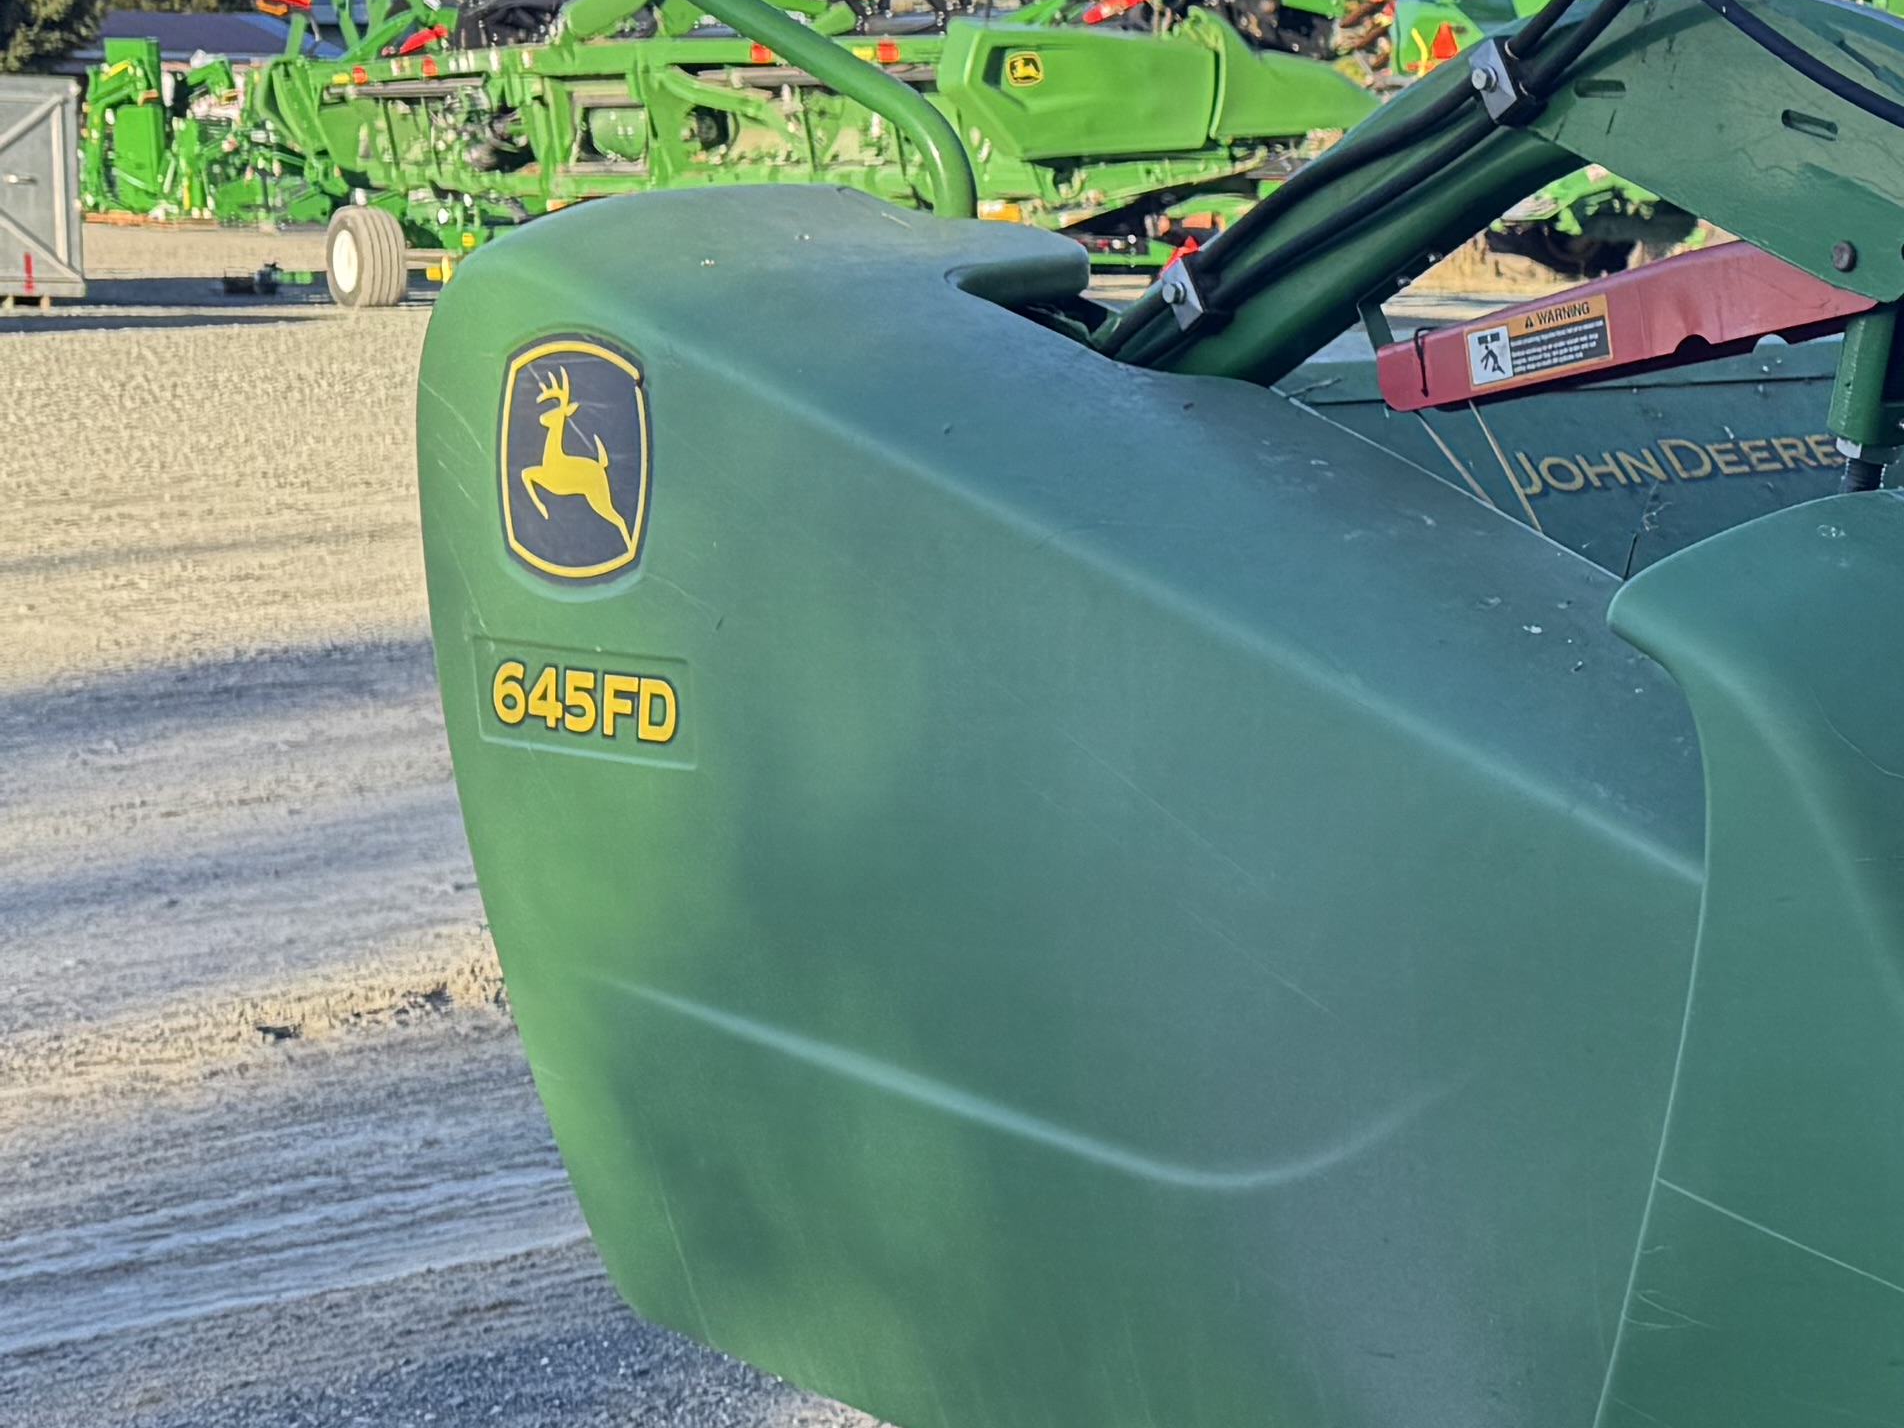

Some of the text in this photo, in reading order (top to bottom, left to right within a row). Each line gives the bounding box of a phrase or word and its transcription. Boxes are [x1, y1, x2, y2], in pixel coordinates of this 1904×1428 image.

[1536, 301, 1591, 325] WARNING
[1514, 434, 1845, 497] JOHN DEERE
[492, 661, 678, 743] 645FD
